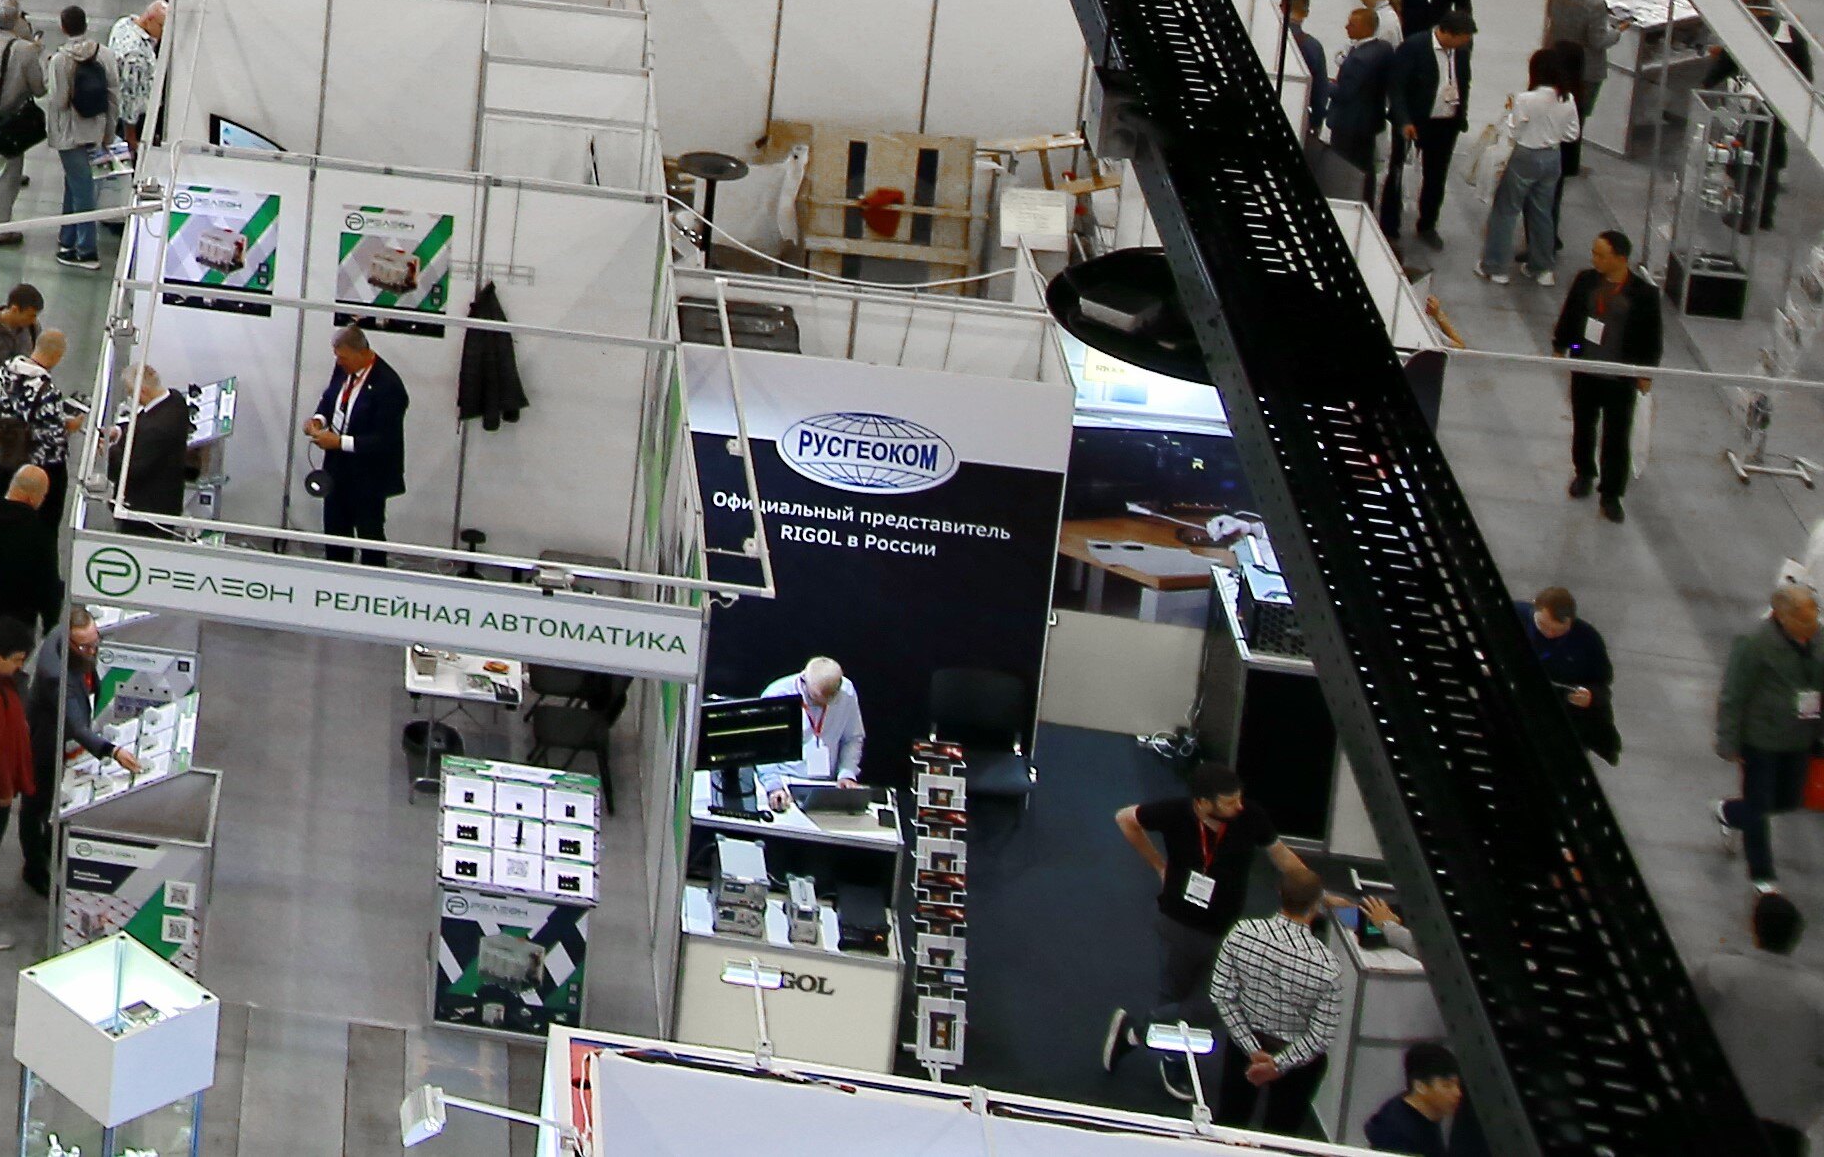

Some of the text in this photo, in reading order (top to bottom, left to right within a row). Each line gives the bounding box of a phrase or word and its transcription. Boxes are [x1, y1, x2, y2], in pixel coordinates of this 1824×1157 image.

[797, 428, 939, 473] РУСГЕОКОМ
[780, 524, 937, 558] RIGOL в России
[859, 509, 1011, 541] представитель
[315, 590, 470, 628] РЕЛЕЙНАЯ
[479, 611, 688, 655] АВТОМАТИКА
[781, 970, 835, 996] GOL
